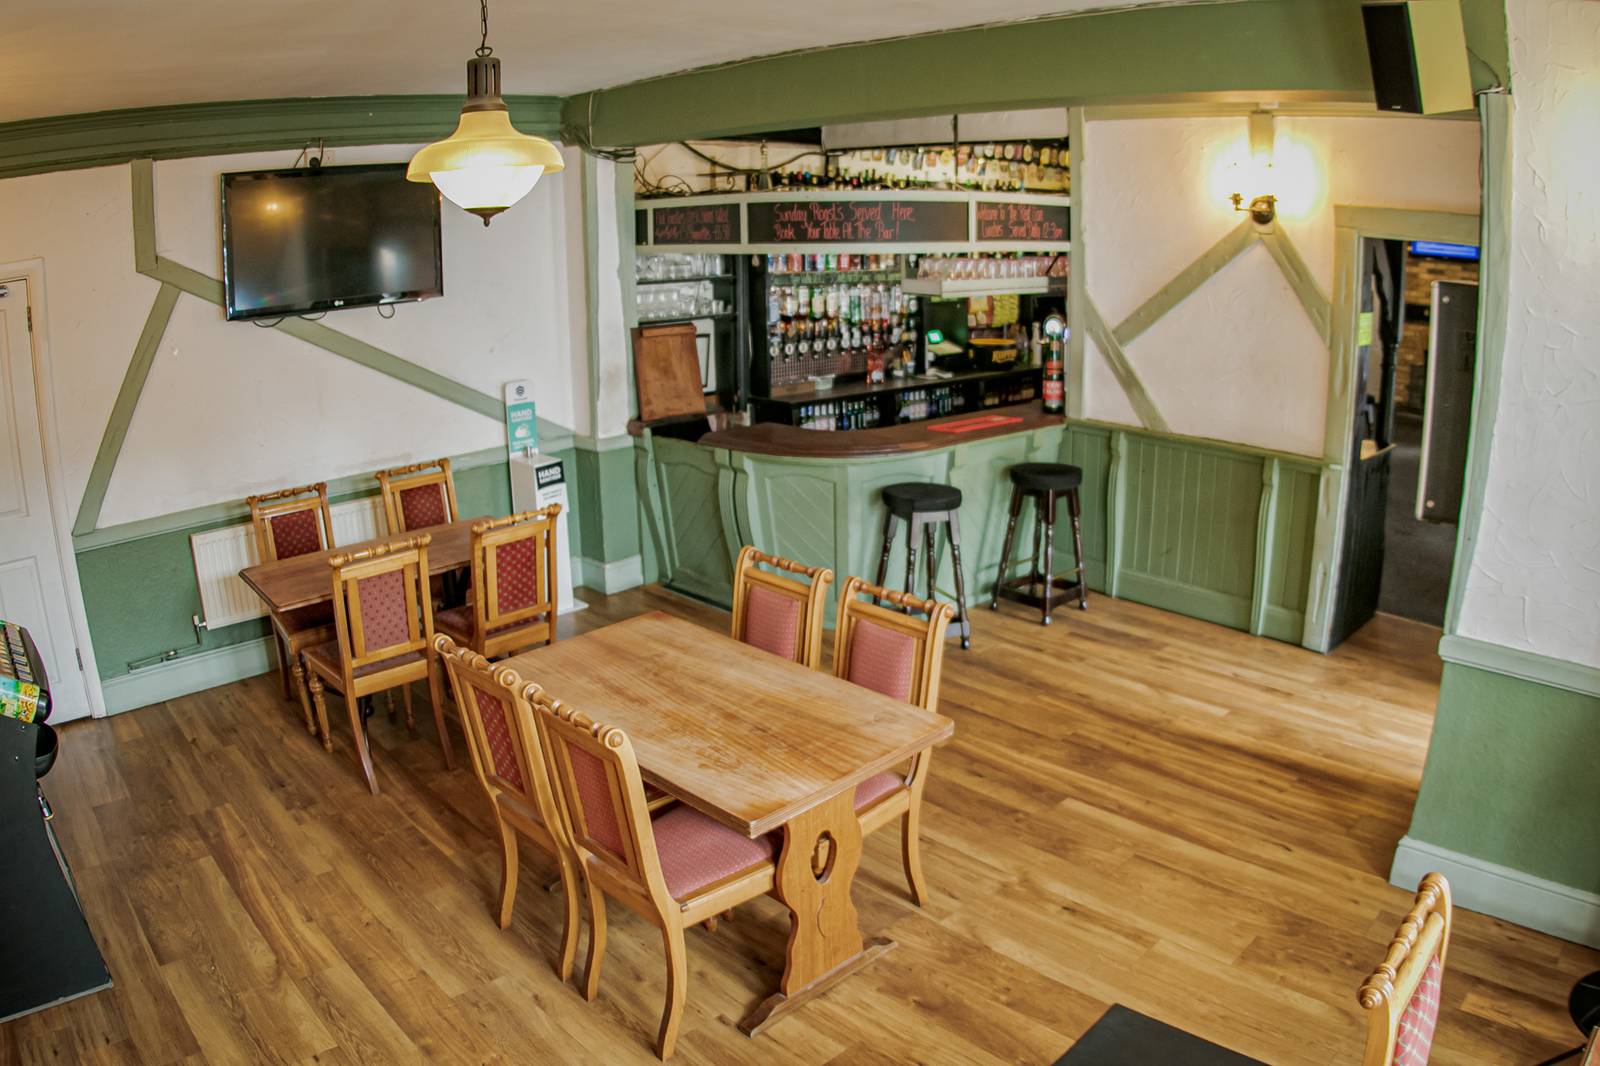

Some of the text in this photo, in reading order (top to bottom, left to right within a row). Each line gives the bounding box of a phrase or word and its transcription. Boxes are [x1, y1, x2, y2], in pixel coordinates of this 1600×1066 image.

[774, 203, 807, 227] Sunday
[849, 201, 881, 222] Served
[892, 201, 916, 221] Here
[774, 223, 796, 240] Book
[800, 222, 820, 240] Your
[511, 408, 532, 418] HAND
[538, 466, 561, 478] HAND
